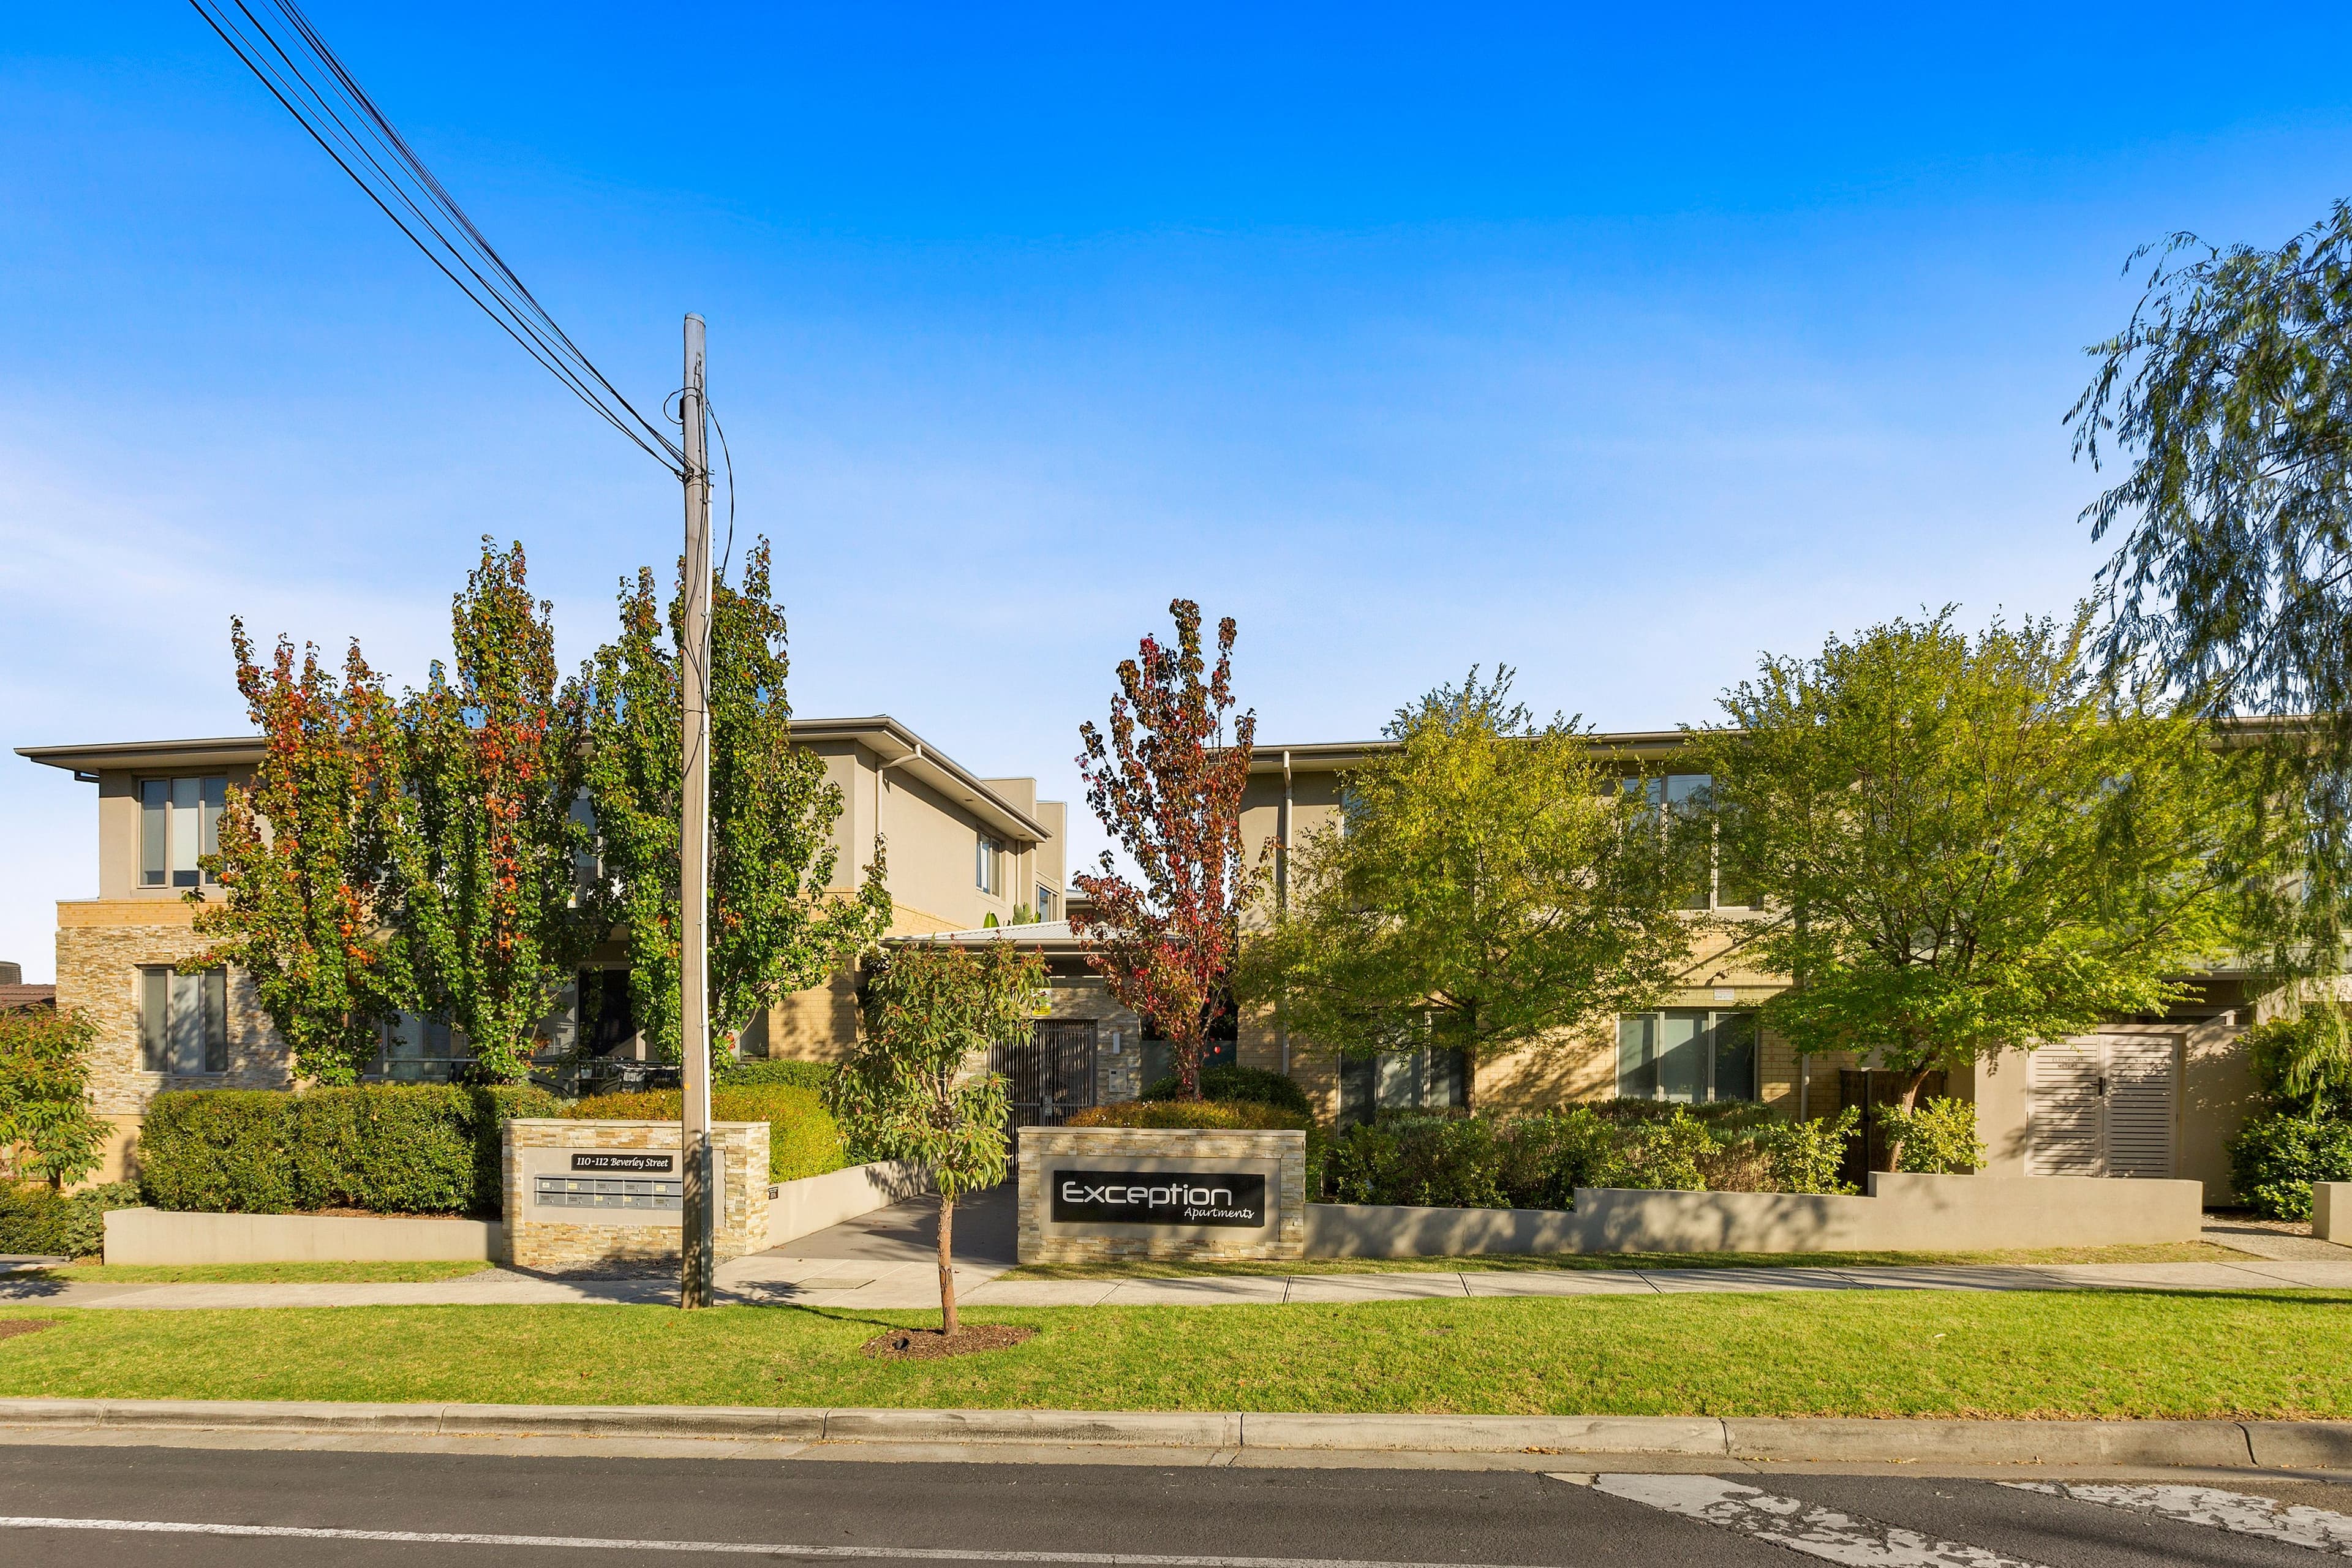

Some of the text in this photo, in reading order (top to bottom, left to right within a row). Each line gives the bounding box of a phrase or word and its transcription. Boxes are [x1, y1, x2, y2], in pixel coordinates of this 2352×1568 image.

[576, 1157, 669, 1169] 110-112 Beverley Street
[1062, 1181, 1232, 1208] Exception
[1183, 1207, 1255, 1221] Apartments
